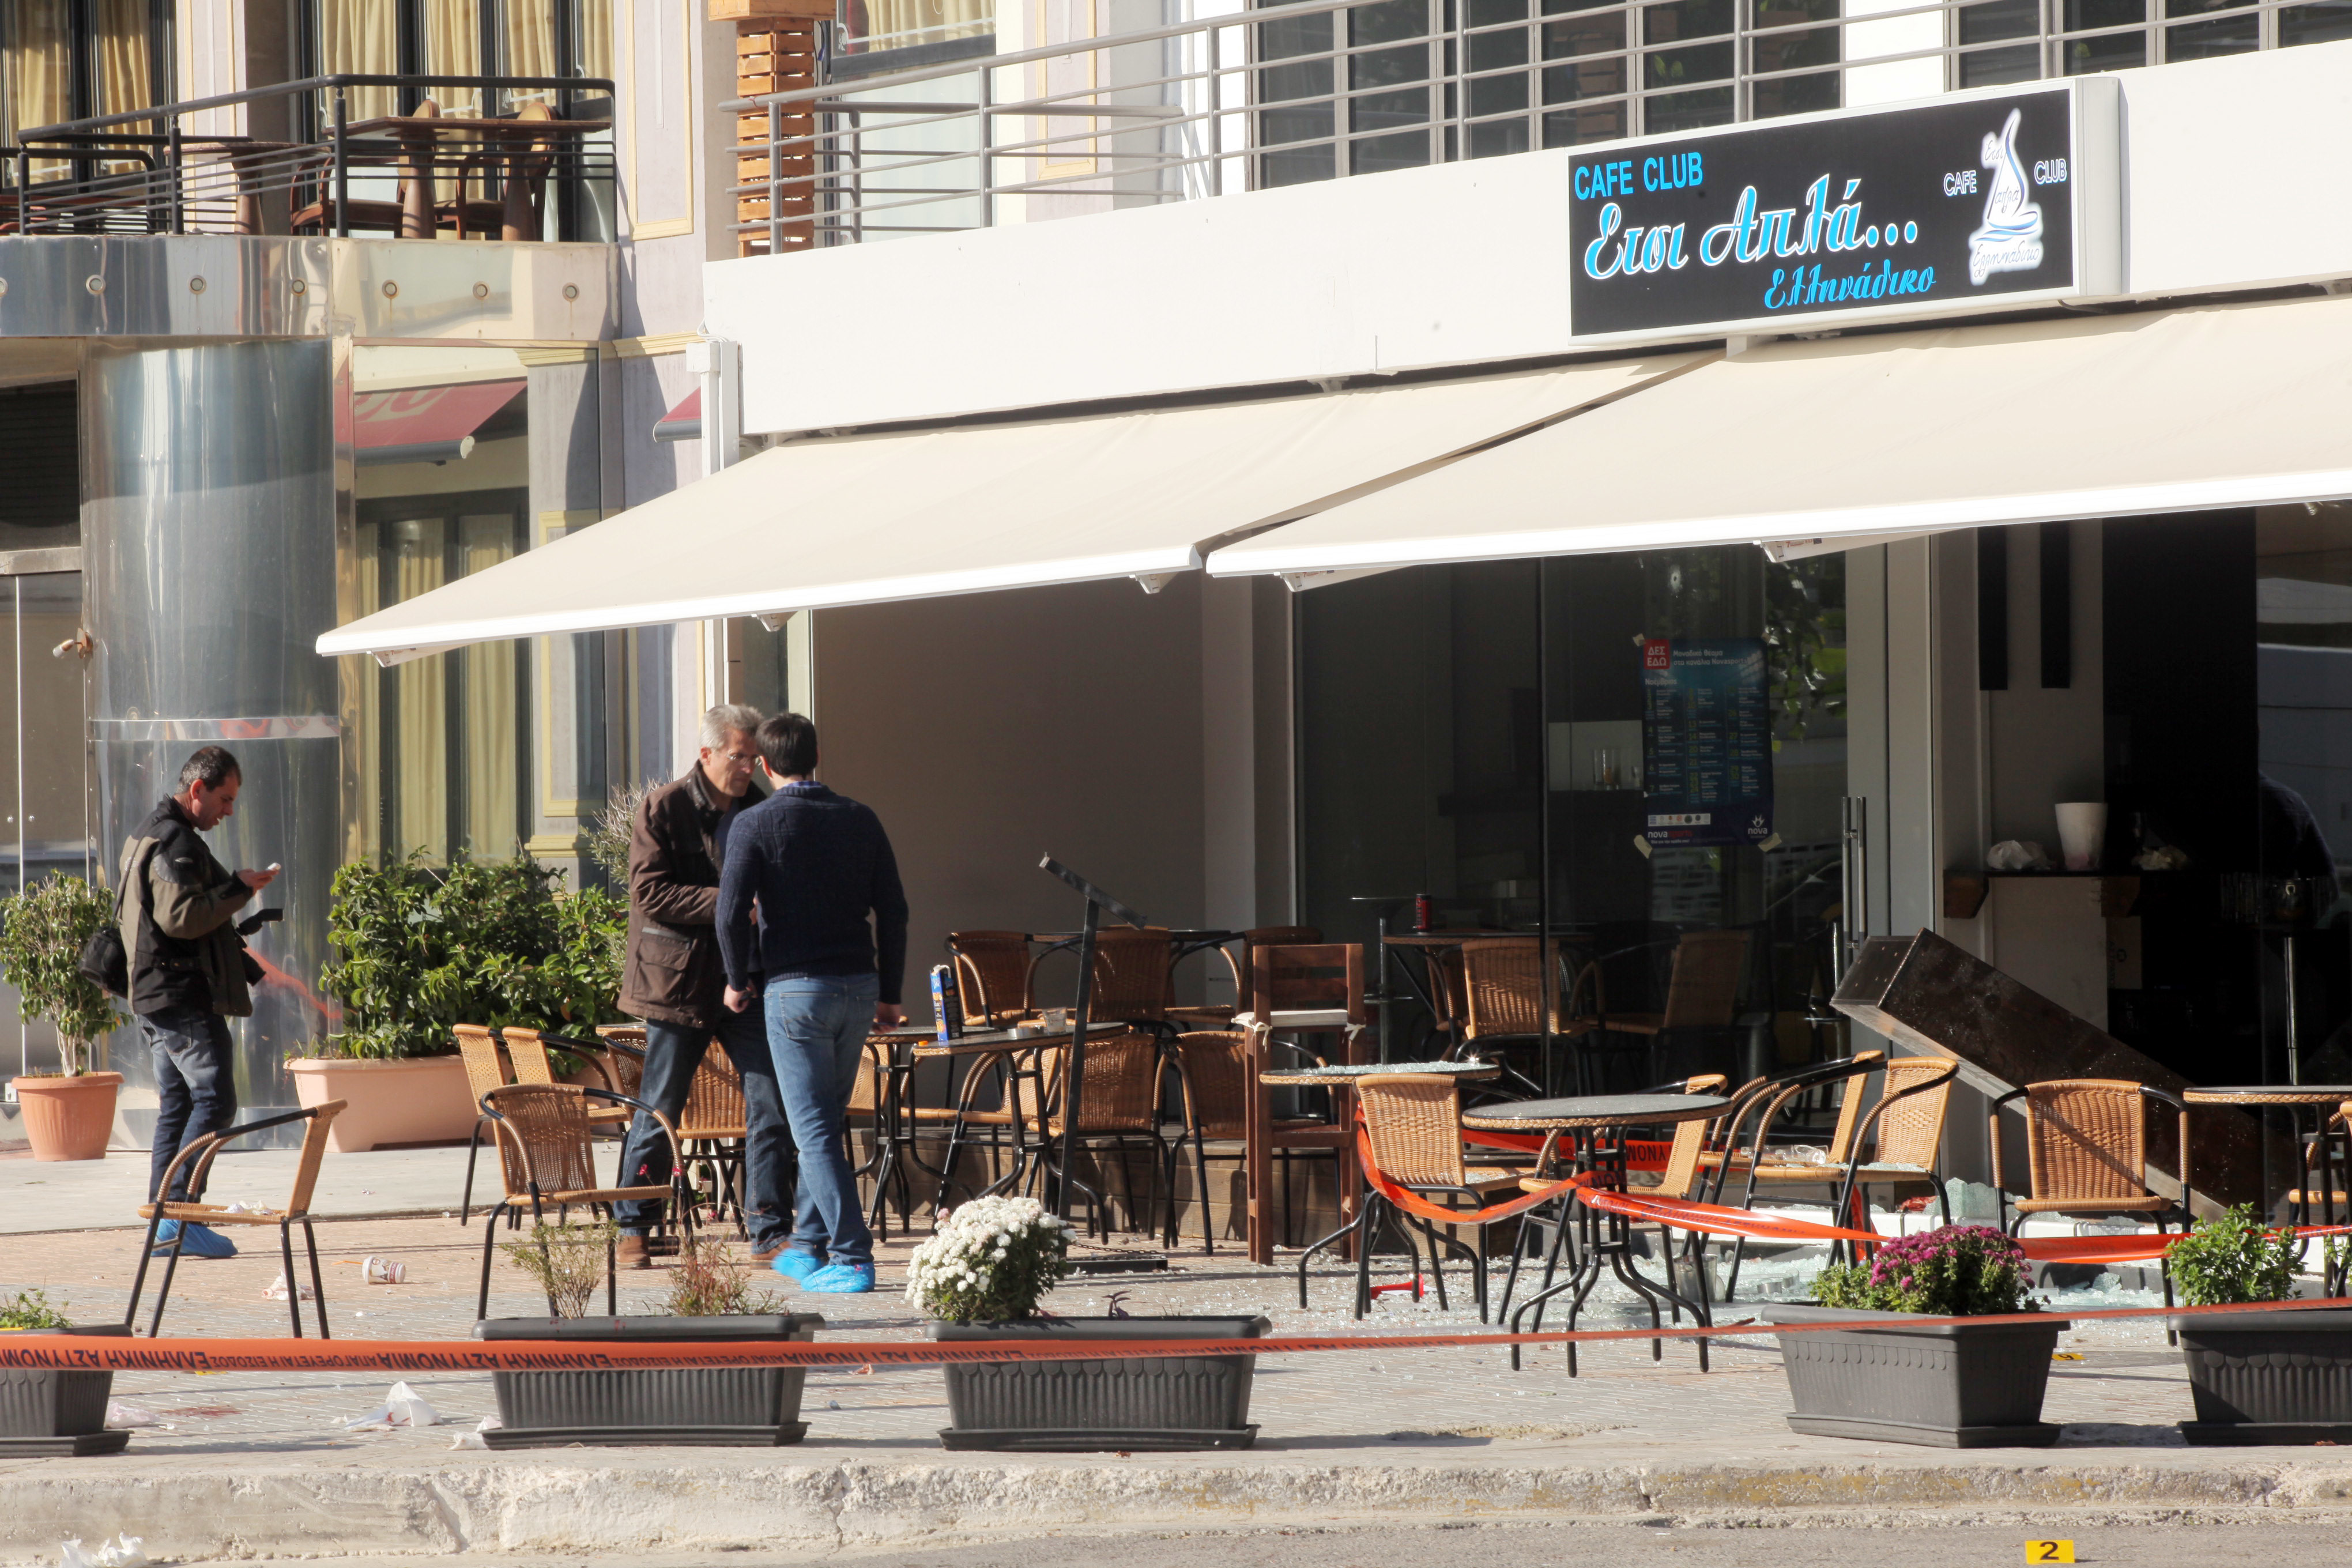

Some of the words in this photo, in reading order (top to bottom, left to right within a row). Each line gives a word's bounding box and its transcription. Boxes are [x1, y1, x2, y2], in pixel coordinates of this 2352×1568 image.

[1574, 161, 1634, 201] CAFE
[1644, 152, 1703, 191] CLUB
[2034, 159, 2067, 185] CLUB
[1943, 169, 1977, 197] CAFE
[1764, 258, 1936, 309] Ελληνάδικο
[1648, 646, 1665, 655] ΔΕΣ
[1647, 657, 1667, 666] ΕΔΩ
[0, 1349, 101, 1368] ΑΣΤΥΝΟΜ
[105, 1350, 212, 1370] ΕΛΛΗΝΙΚΗ
[209, 1356, 268, 1368] ΕΙΣΟΔΟΣ
[280, 1355, 377, 1367] ΑΠΑΓΟΡΕΥΕΤΑΙ
[376, 1353, 500, 1369] ΑΣΤΥΝΟΜΙΑ
[503, 1353, 612, 1369] ΕΛΛΗΝΙΚΗ
[2039, 1540, 2060, 1561] 2
